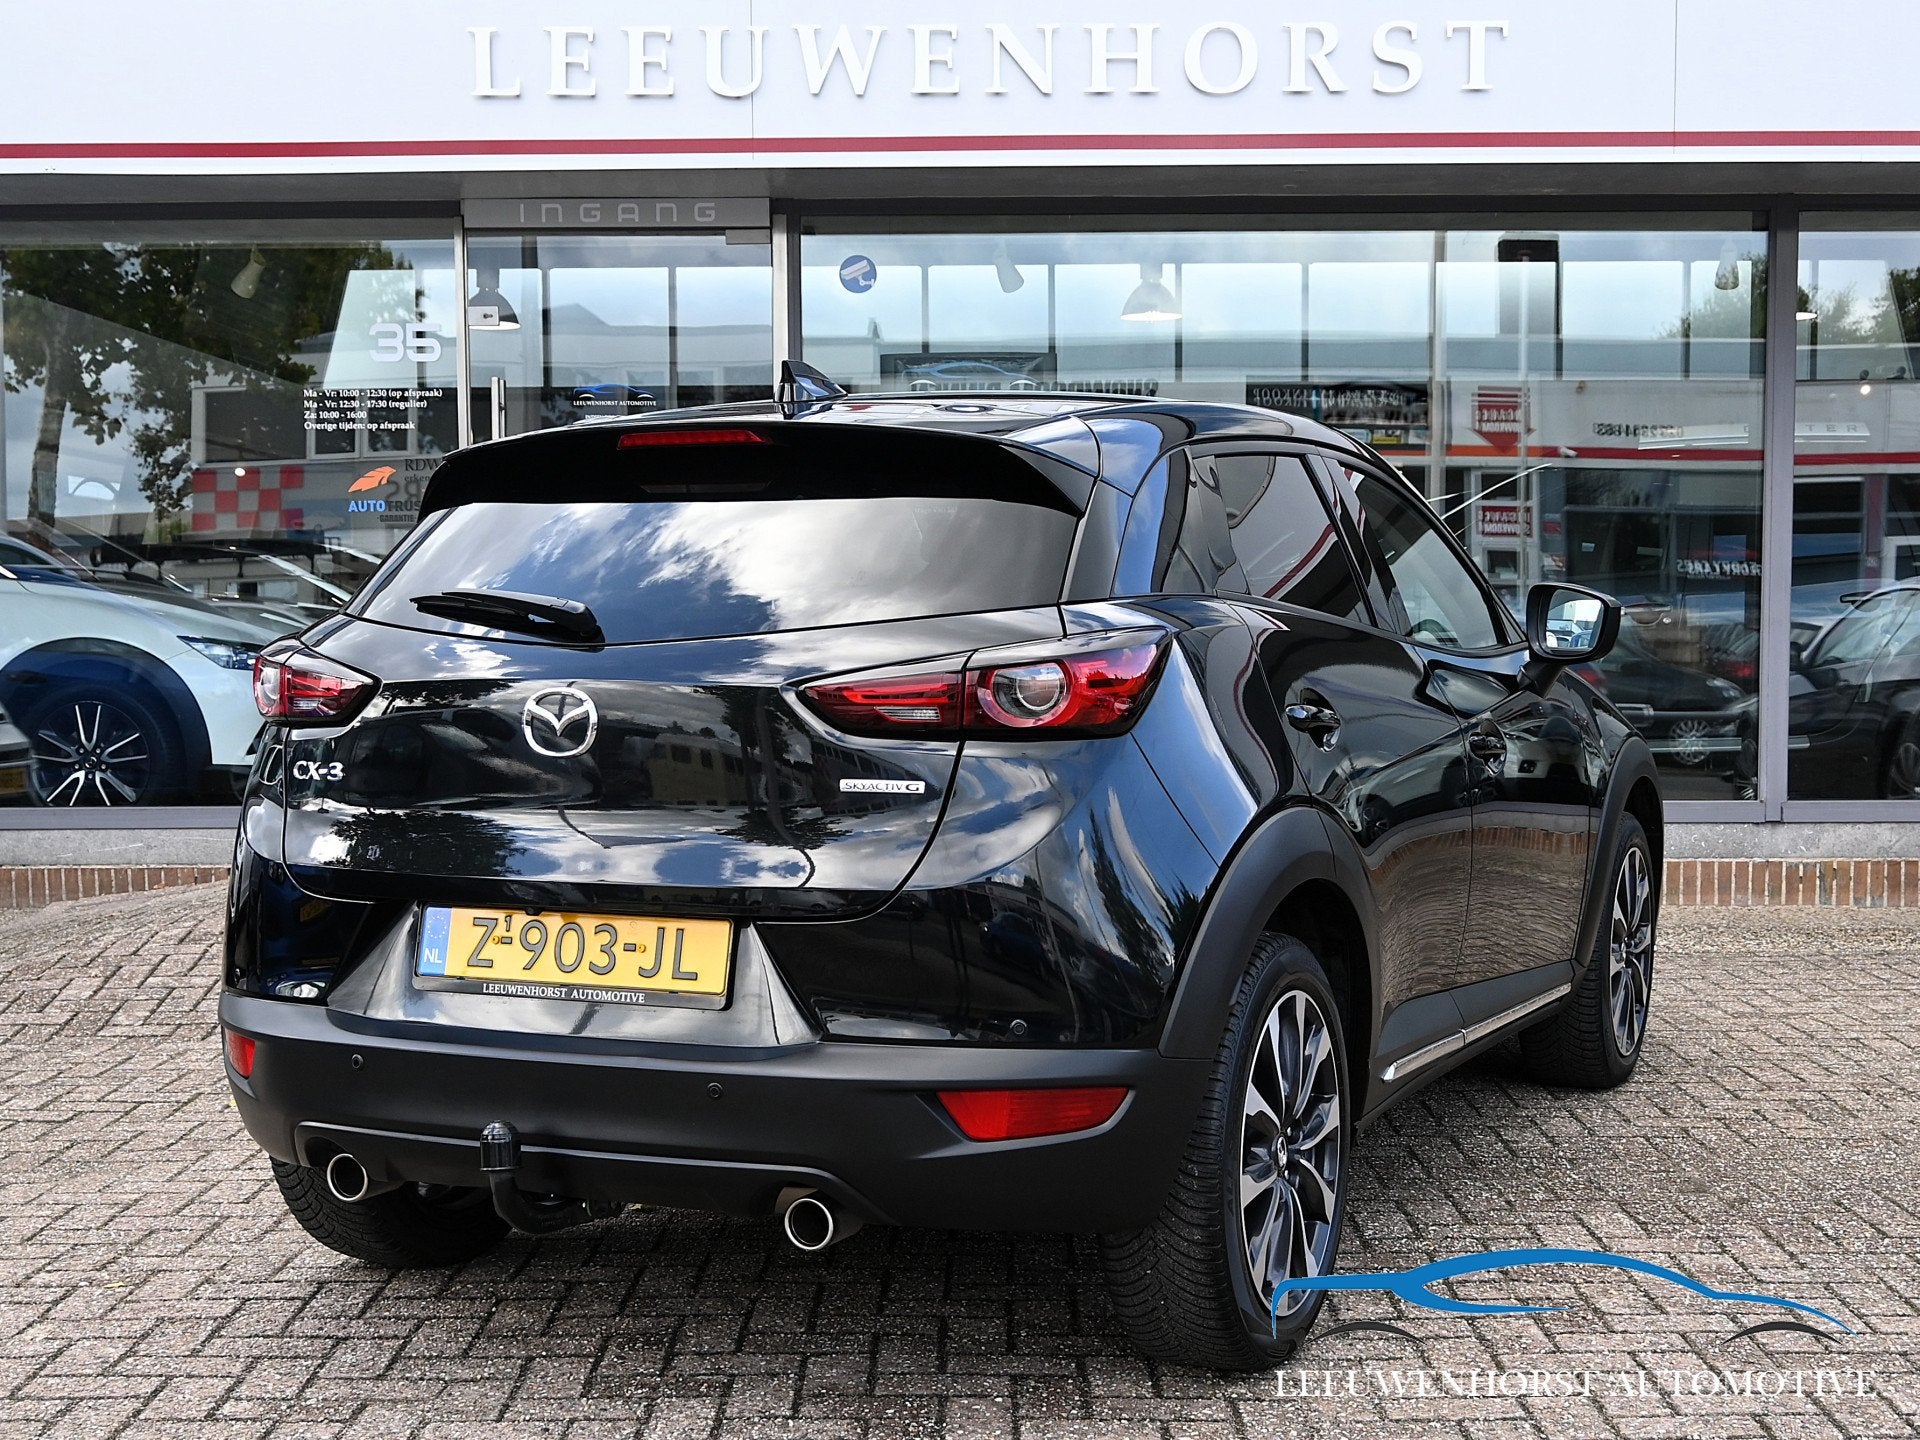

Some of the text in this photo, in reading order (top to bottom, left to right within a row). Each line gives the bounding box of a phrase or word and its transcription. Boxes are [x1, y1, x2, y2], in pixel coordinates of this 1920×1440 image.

[467, 19, 1509, 98] LEEUWENHORST
[519, 202, 716, 223] INGANG
[368, 322, 442, 362] 35
[303, 389, 318, 397] Ma
[324, 389, 337, 397] Vr:
[339, 389, 359, 397] 10:00
[366, 389, 387, 397] 12:30
[388, 389, 402, 399] (op
[404, 389, 442, 399] afspraak)
[303, 400, 318, 408] Ma
[324, 400, 337, 408] Vr:
[339, 400, 359, 408] 12:30
[366, 400, 387, 408] 17:30
[388, 400, 427, 410] (regulier)
[304, 421, 415, 431] Overige tijden: op afspraak
[348, 500, 420, 512] AUTOTRUS
[293, 760, 344, 780] CX-3
[423, 947, 442, 964] NL
[466, 916, 698, 981] Z-903-JL
[482, 982, 645, 1003] LEEUWENHORST AUTOMOTIVE
